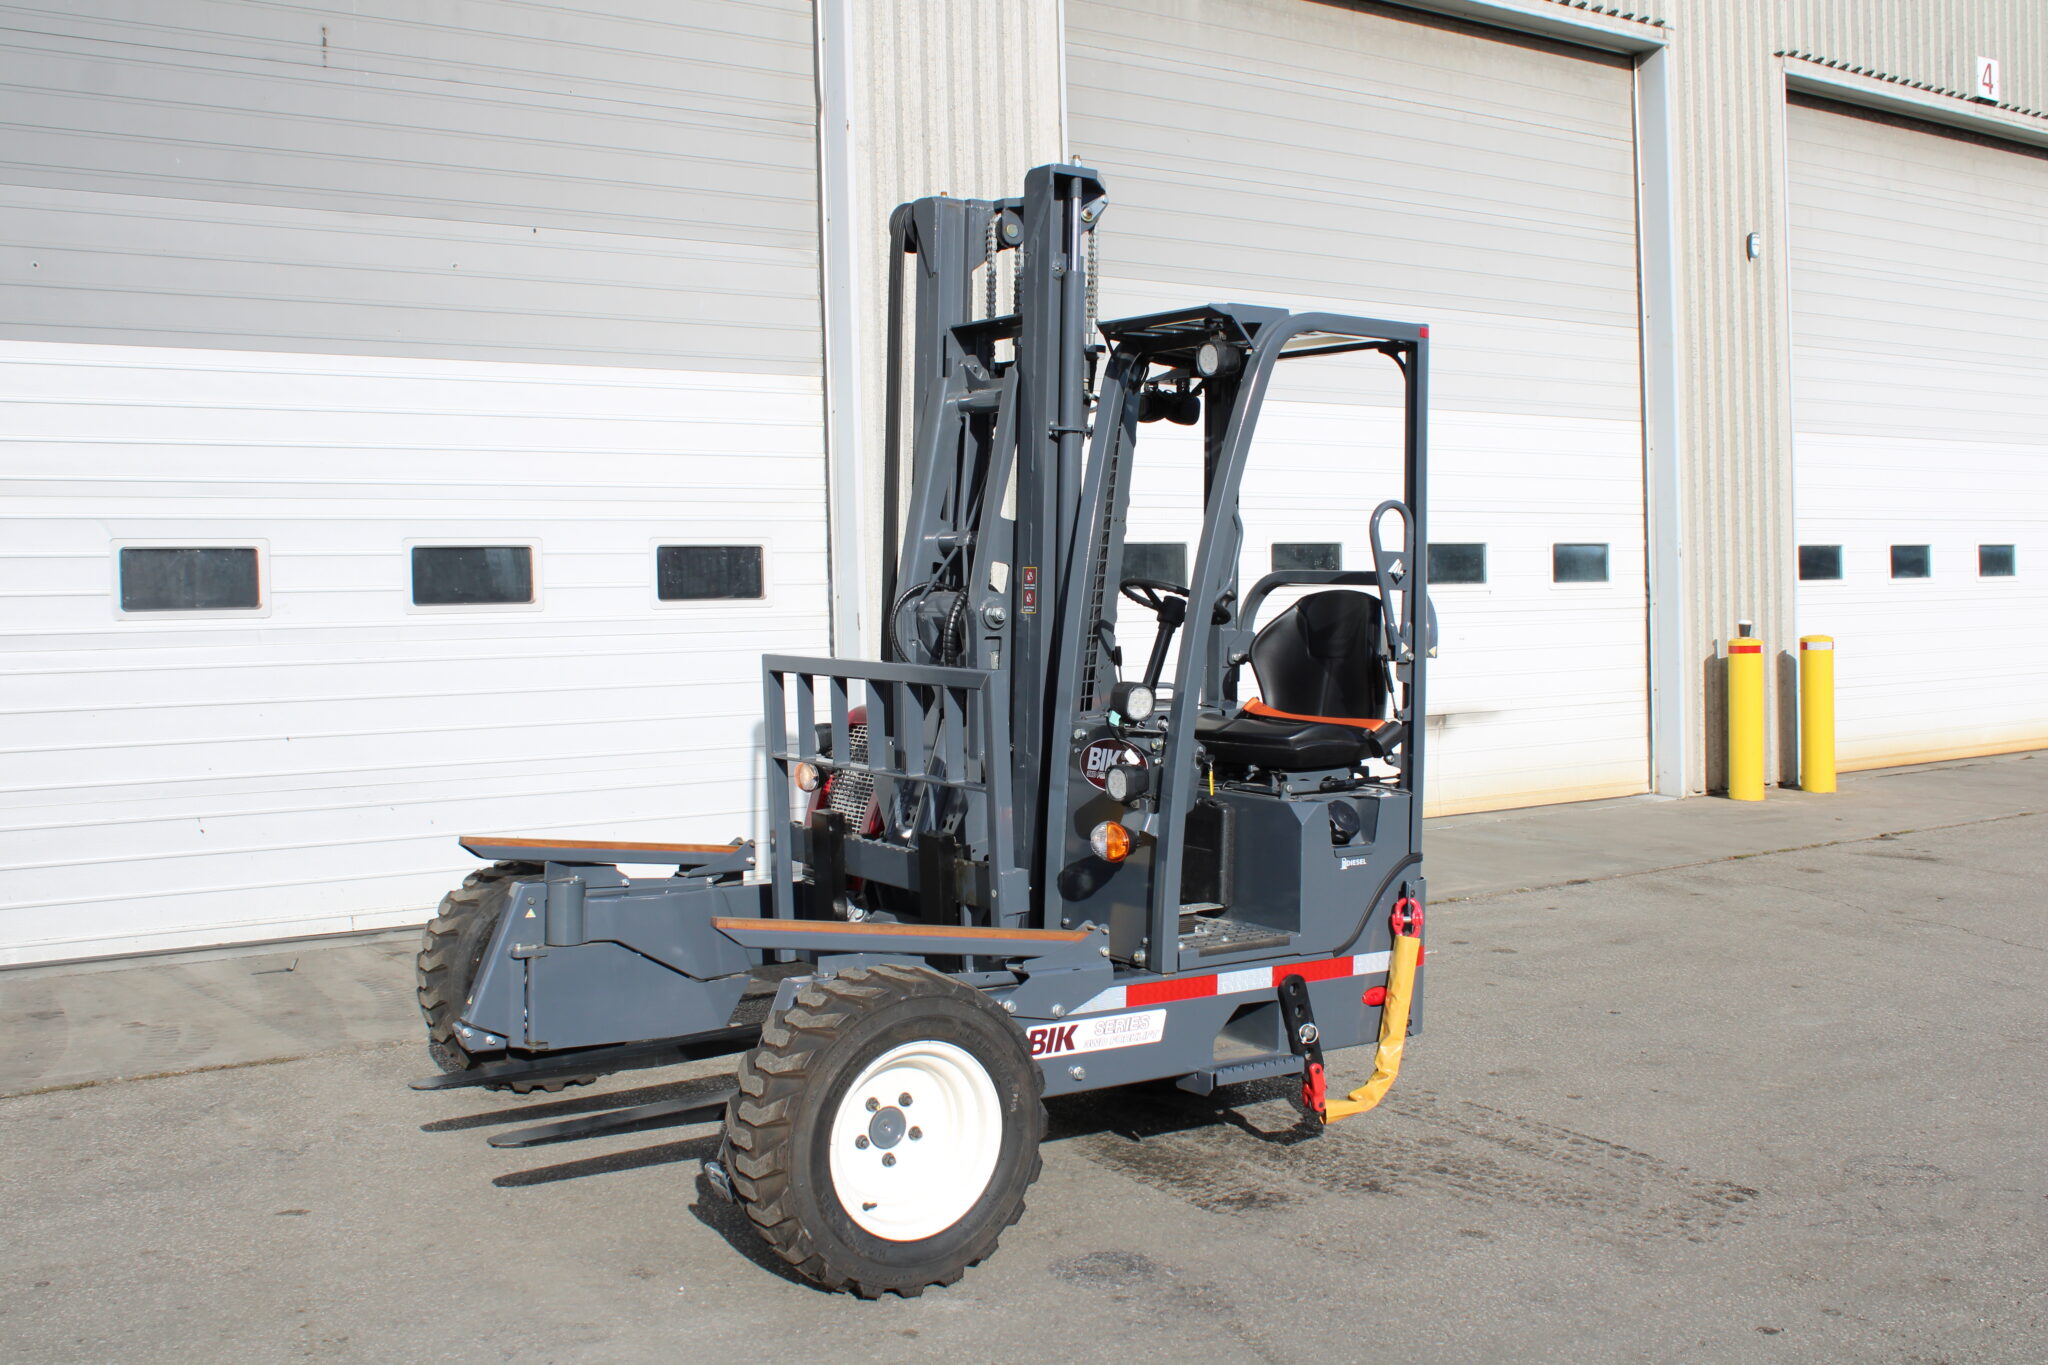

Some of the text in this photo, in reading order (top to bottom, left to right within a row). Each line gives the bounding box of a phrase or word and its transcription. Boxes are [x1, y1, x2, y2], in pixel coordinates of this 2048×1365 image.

[1982, 63, 1994, 95] 4
[1087, 746, 1121, 771] BIK
[1029, 1014, 1150, 1055] BIK SERIES
